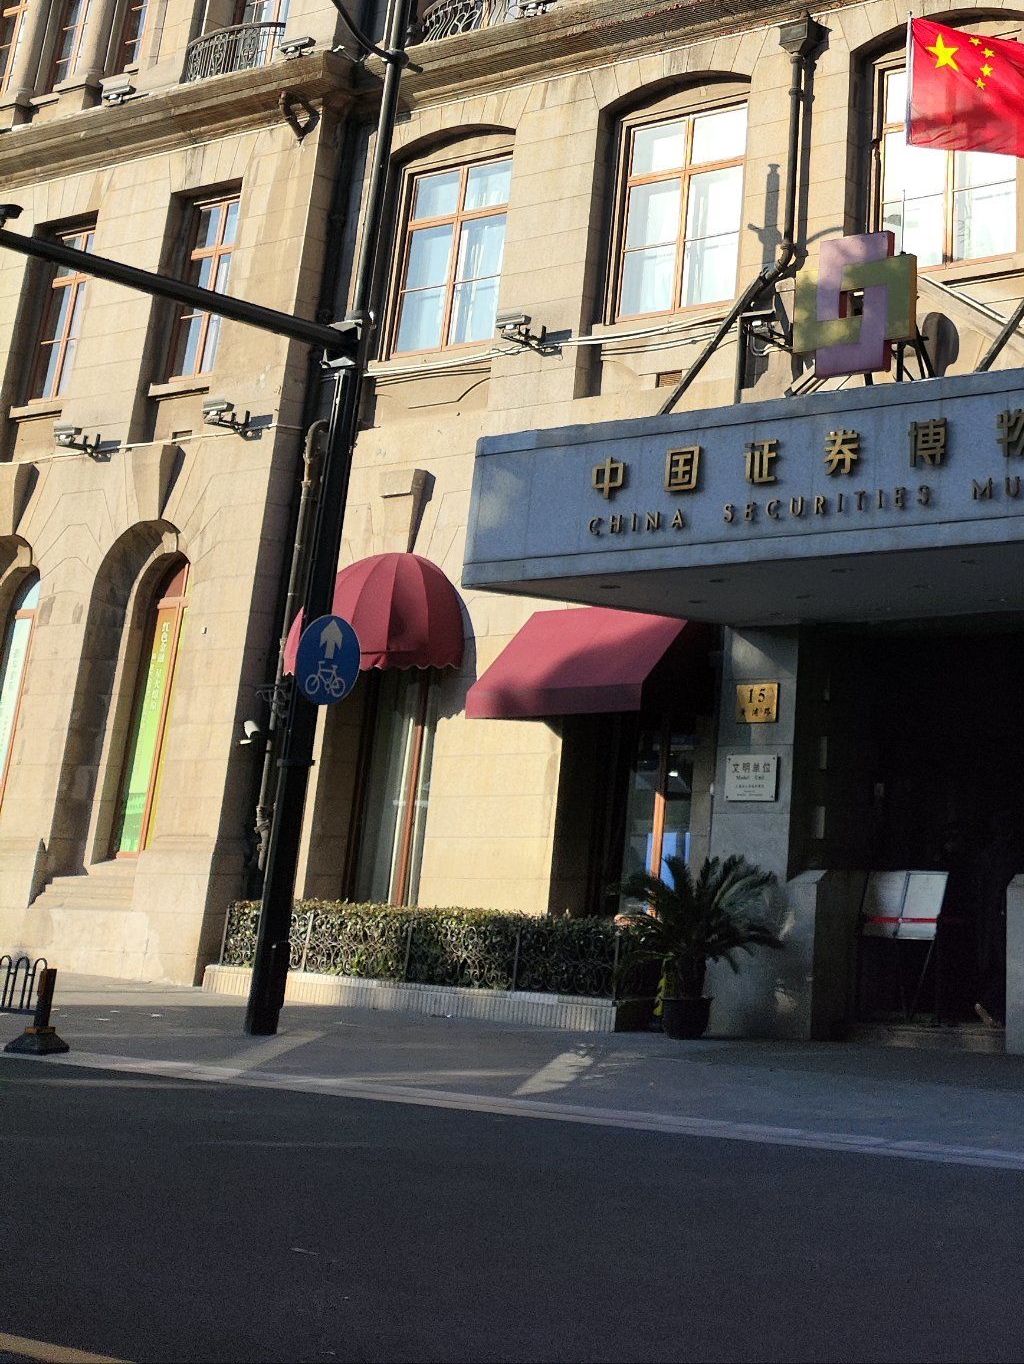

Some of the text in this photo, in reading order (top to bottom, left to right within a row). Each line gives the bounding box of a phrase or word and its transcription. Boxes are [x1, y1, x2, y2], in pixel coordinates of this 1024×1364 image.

[588, 509, 684, 535] CHINA
[723, 484, 933, 524] SECURITIES
[748, 688, 765, 703] 15
[732, 762, 771, 773] 文明单位
